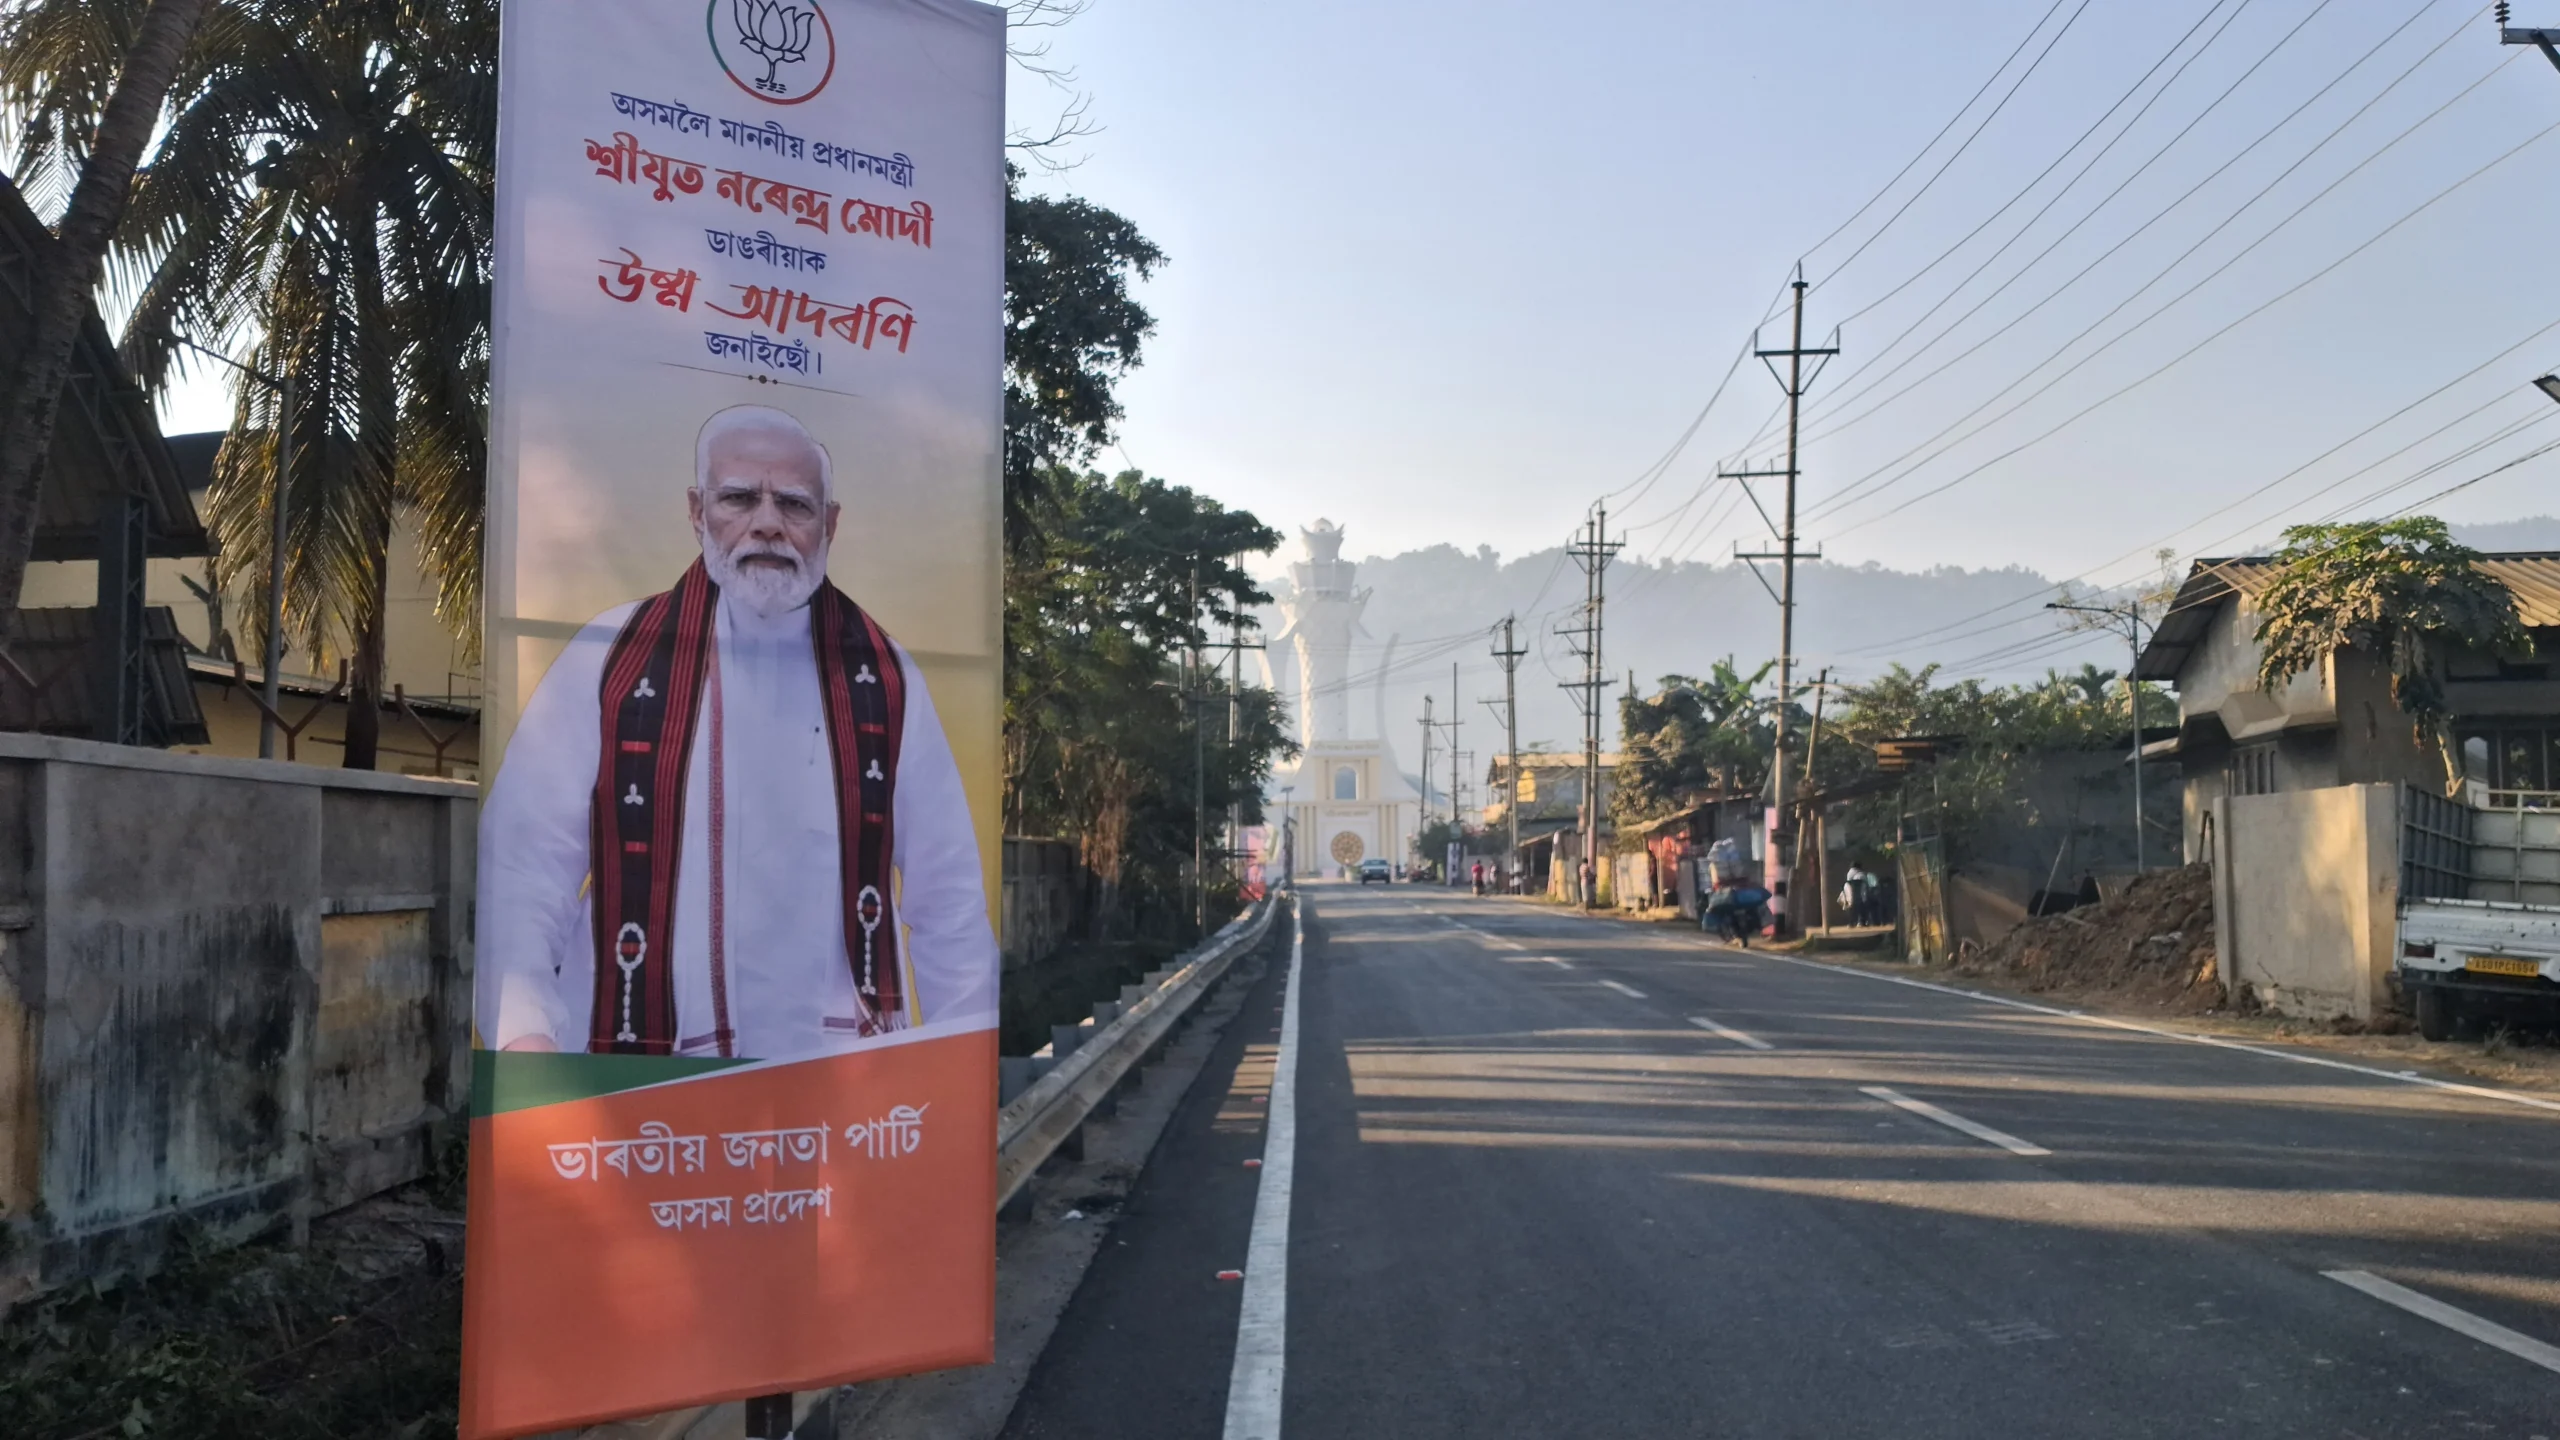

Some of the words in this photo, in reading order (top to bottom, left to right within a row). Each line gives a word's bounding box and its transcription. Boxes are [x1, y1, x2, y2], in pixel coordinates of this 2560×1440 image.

[611, 92, 710, 137] অসমলৈ
[719, 120, 805, 160] মাননীয়
[584, 131, 707, 202] শ্ৰীযুত
[715, 168, 832, 234] নৰেন্দ্ৰ
[841, 199, 934, 249] মোদী
[705, 228, 827, 274] ডাঙৰীয়াক
[705, 284, 917, 354] আদৰণি
[547, 1121, 709, 1181] ভাৰতীয়
[720, 1121, 831, 1170] জনতা
[650, 1196, 733, 1231] অসম
[743, 1183, 833, 1224] প্ৰদেশ
